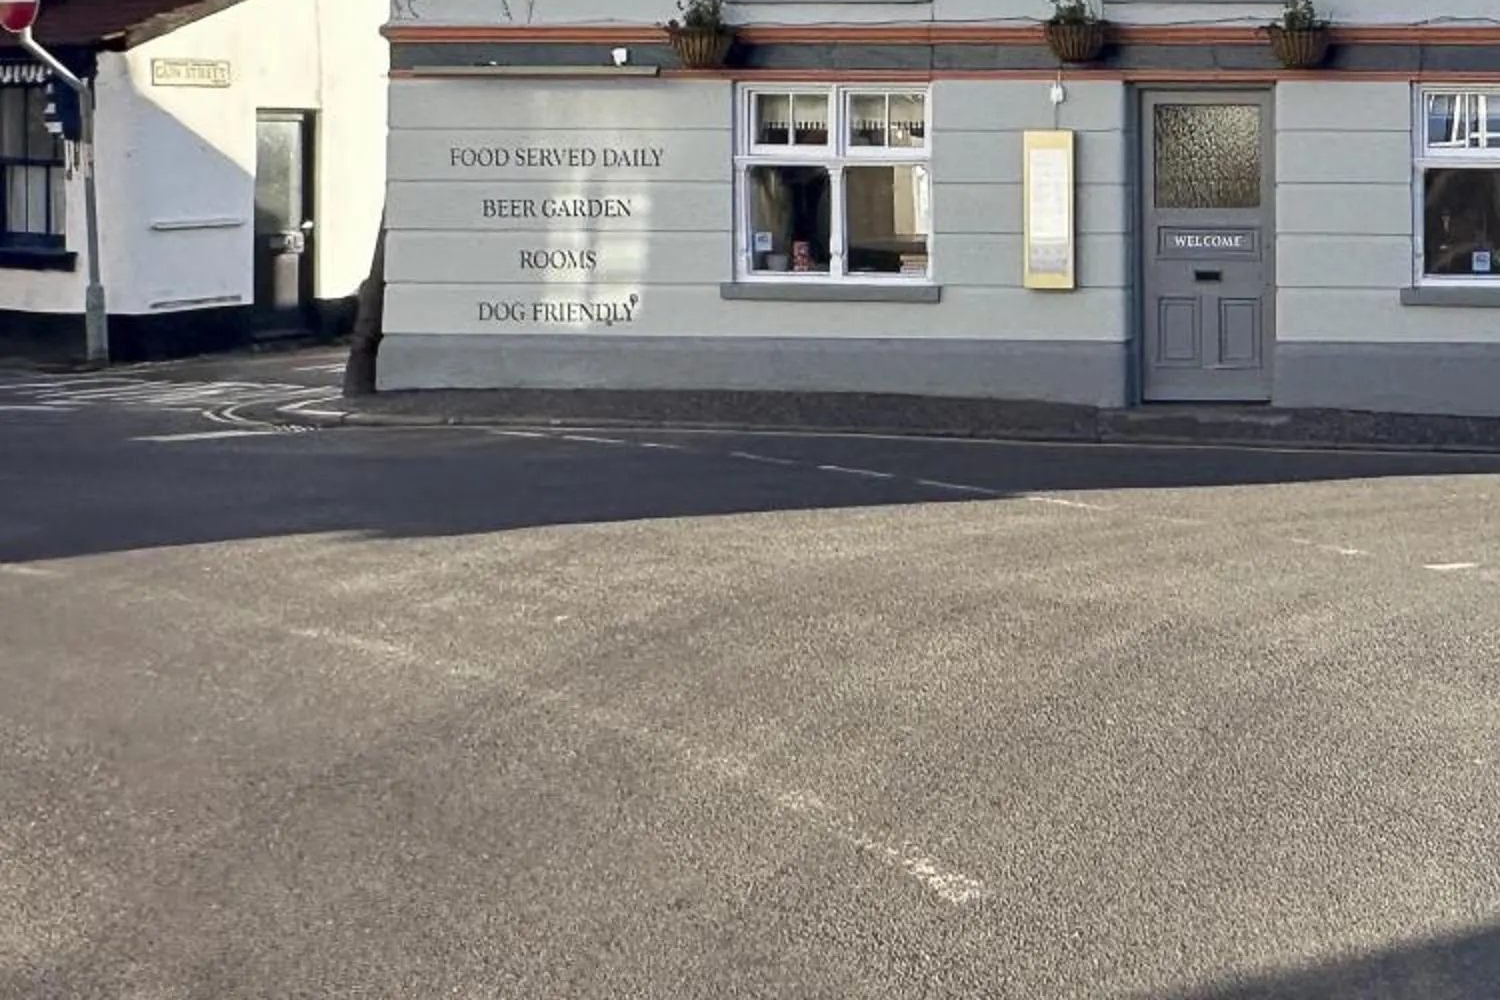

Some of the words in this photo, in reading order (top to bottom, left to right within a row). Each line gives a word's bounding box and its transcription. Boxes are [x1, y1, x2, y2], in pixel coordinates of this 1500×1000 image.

[450, 147, 510, 167] FOOD
[515, 147, 597, 167] SERVED
[603, 148, 664, 168] DAILY
[483, 199, 537, 218] BEER
[541, 199, 632, 218] GARDEN
[1174, 235, 1243, 248] WELCOME
[520, 249, 597, 270] ROOMS
[478, 302, 526, 322] DOG
[532, 296, 639, 325] FRIENDLY
